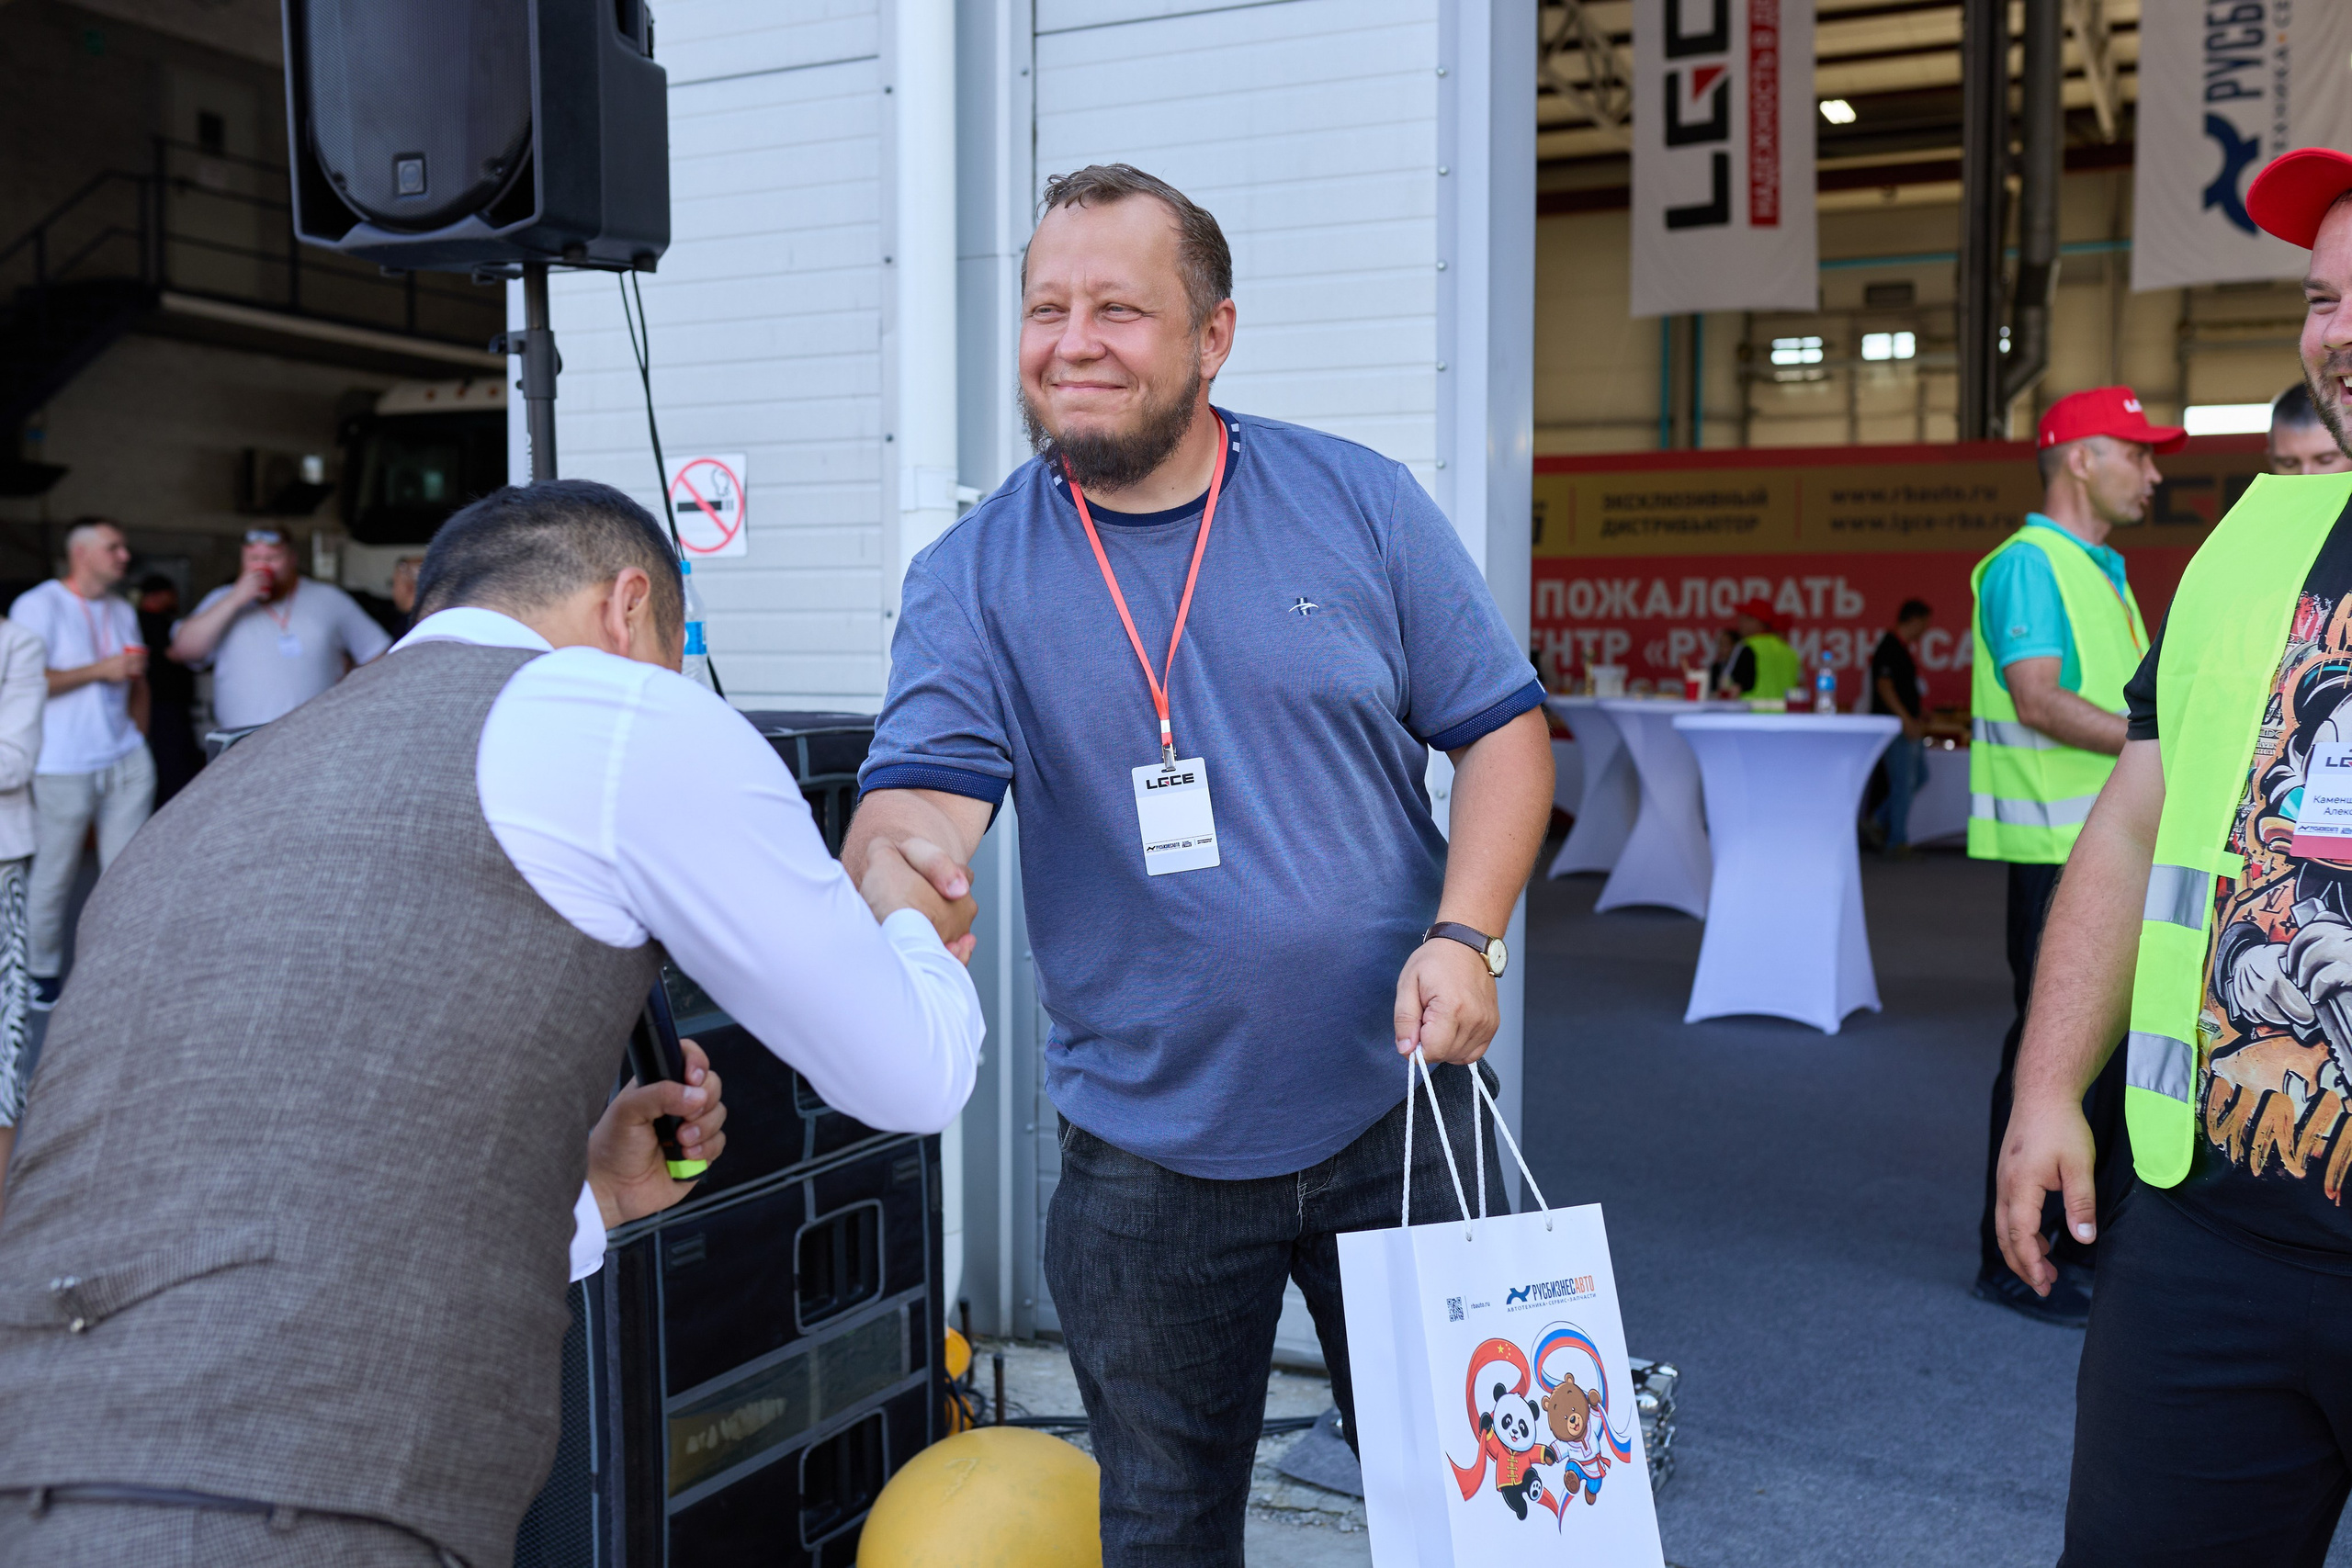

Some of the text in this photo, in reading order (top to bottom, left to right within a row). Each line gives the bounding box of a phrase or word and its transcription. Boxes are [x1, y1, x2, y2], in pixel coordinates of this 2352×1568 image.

[2206, 0, 2265, 102] РУСБ
[1146, 773, 1194, 789] LGCE
[1532, 1275, 1594, 1301] РУСБИЗНЕСАВТО
[1471, 1301, 1490, 1309] rbauto.ru
